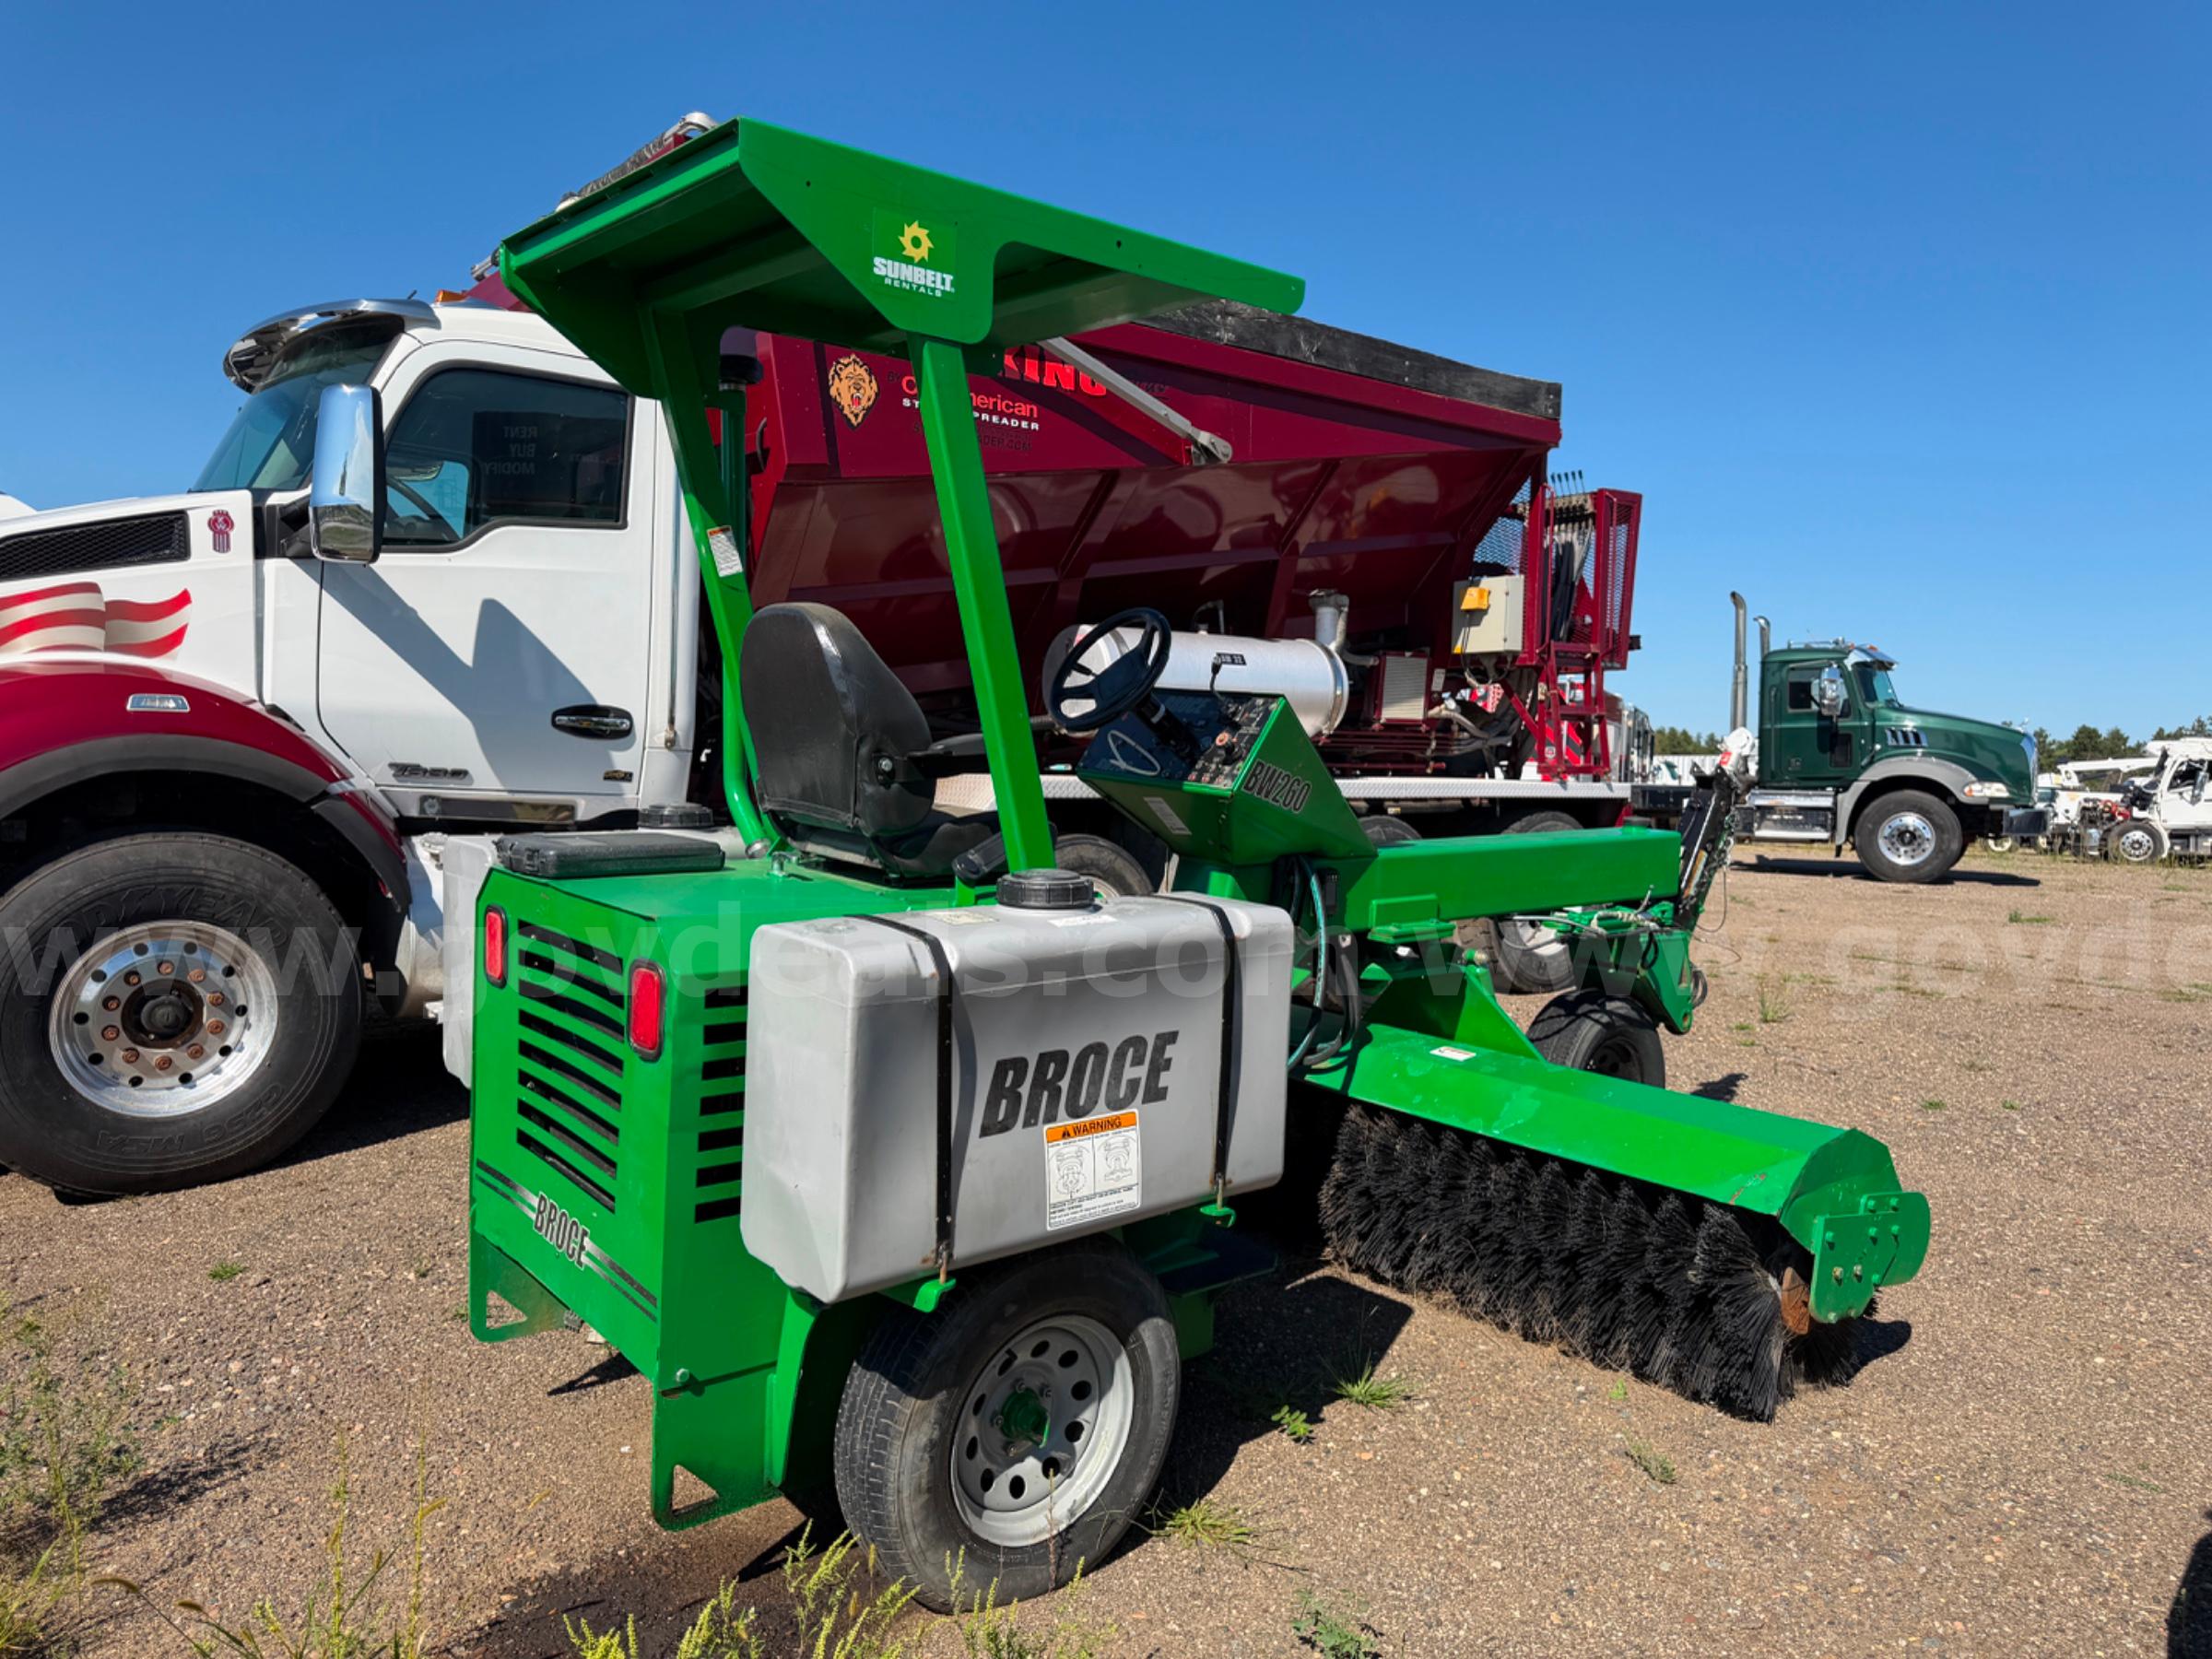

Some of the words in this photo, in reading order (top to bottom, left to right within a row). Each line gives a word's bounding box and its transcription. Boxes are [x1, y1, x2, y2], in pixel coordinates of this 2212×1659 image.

[873, 256, 954, 292] SUNBELT
[884, 276, 942, 298] RENTALS
[970, 393, 1038, 418] erican
[972, 411, 1041, 431] PREADER
[1241, 759, 1312, 815] BW260
[979, 1030, 1180, 1138] BROCE
[1072, 1115, 1122, 1136] WARNING
[533, 1192, 590, 1271] BROCE
